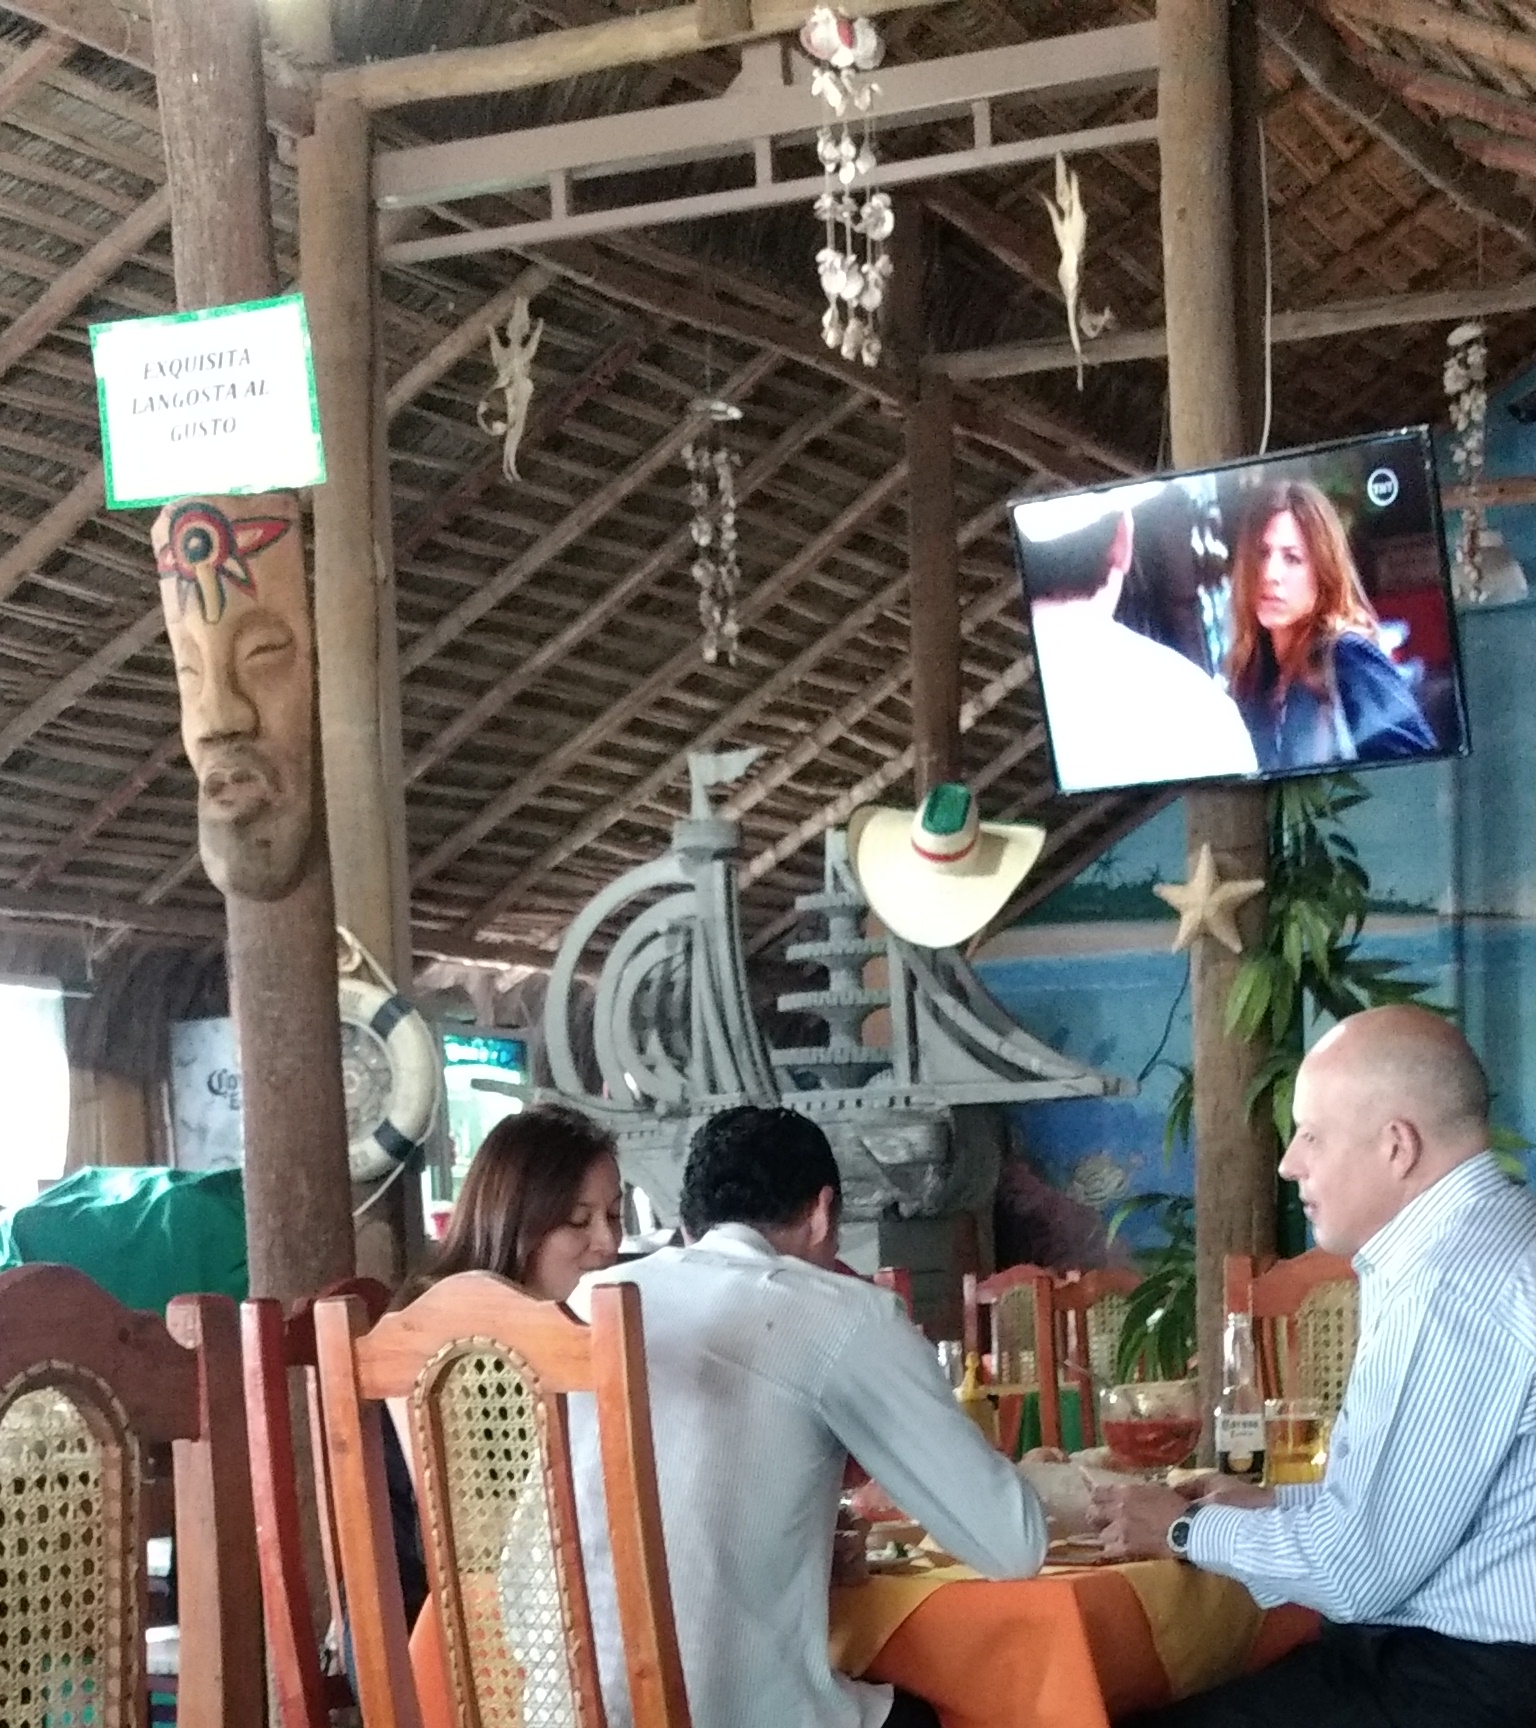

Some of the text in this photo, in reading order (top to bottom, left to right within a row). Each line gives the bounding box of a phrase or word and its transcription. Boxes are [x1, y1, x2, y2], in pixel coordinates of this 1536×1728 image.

[143, 347, 251, 380] EXQUISITA
[132, 379, 270, 415] LANGOSTA AL
[170, 416, 238, 442] GUSTO
